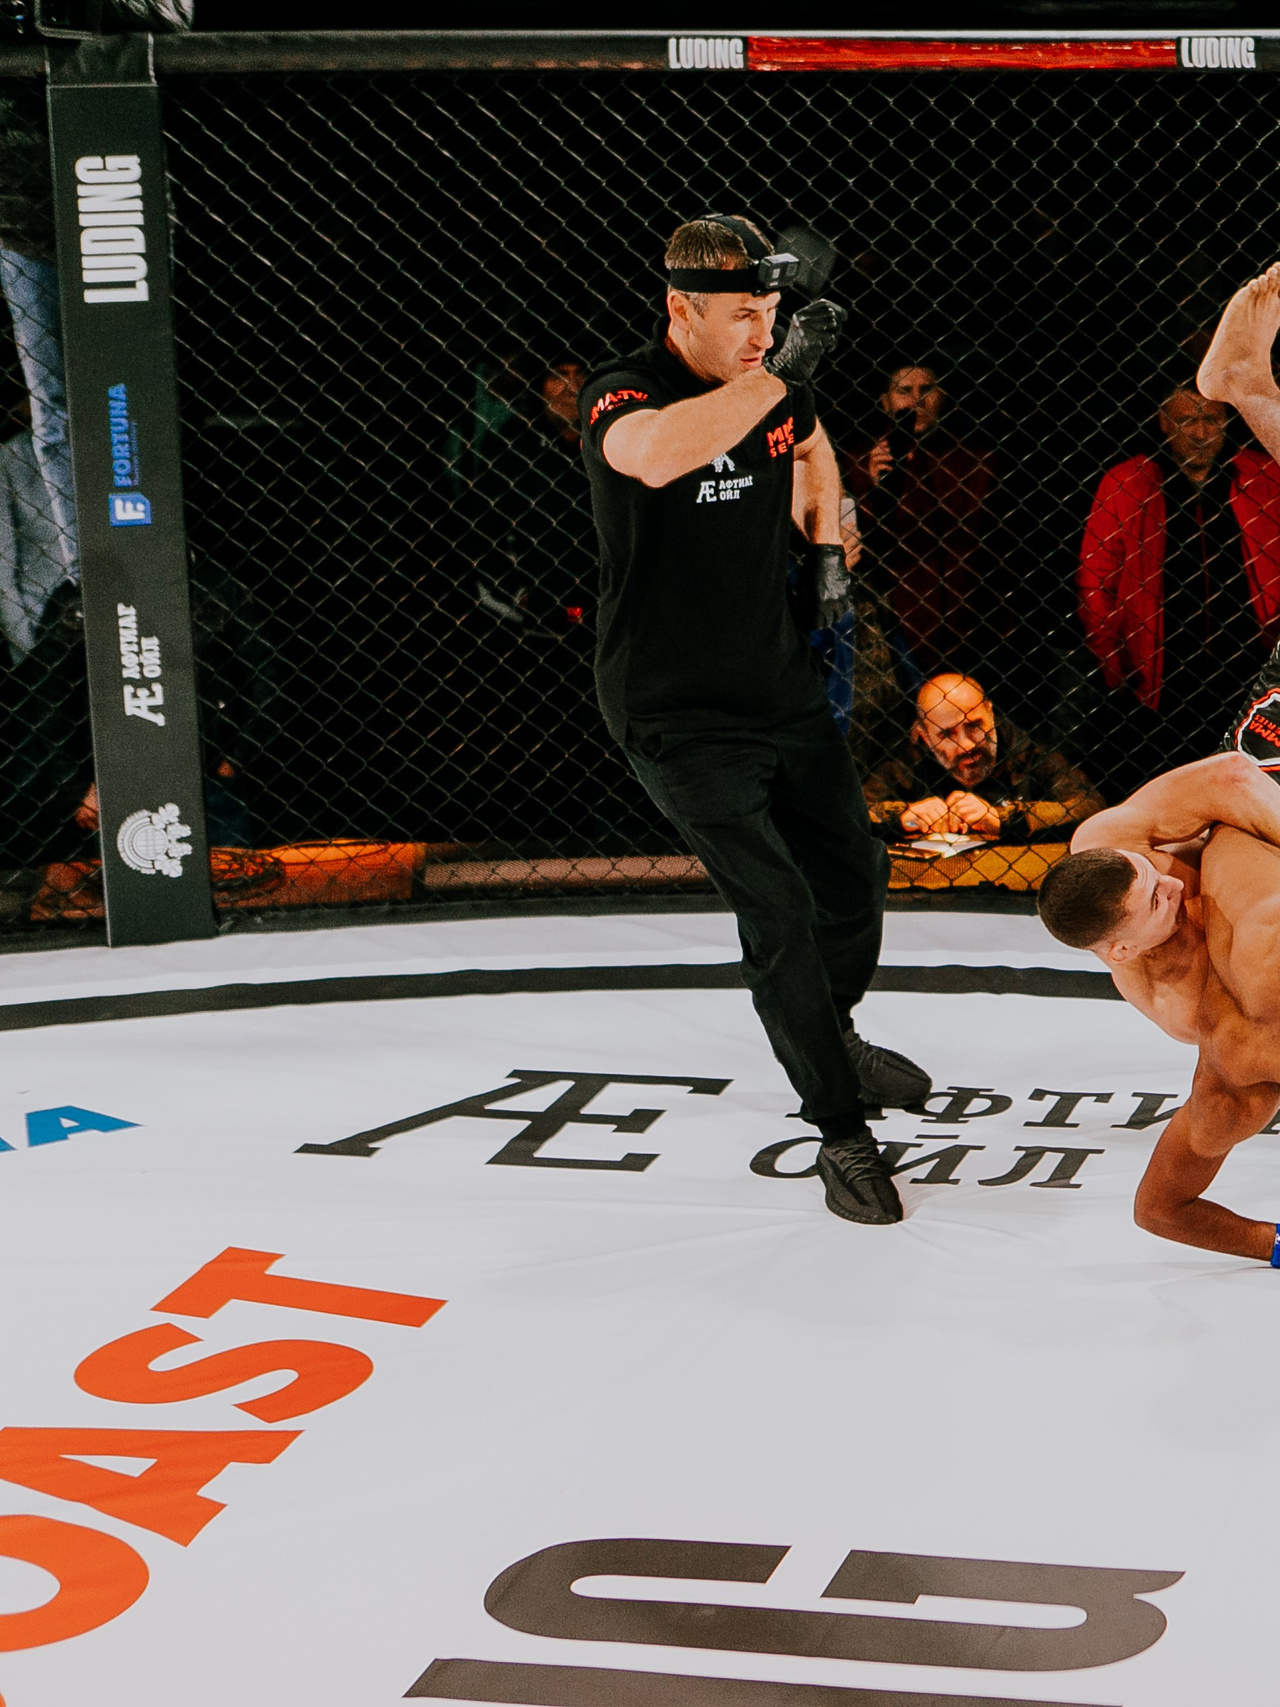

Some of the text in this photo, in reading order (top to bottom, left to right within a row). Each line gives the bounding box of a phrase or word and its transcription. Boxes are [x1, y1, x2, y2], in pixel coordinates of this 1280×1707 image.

[668, 38, 744, 69] LUDING
[1181, 36, 1256, 69] LUDING
[75, 154, 149, 303] LUDING
[107, 383, 133, 487] FORTUNA
